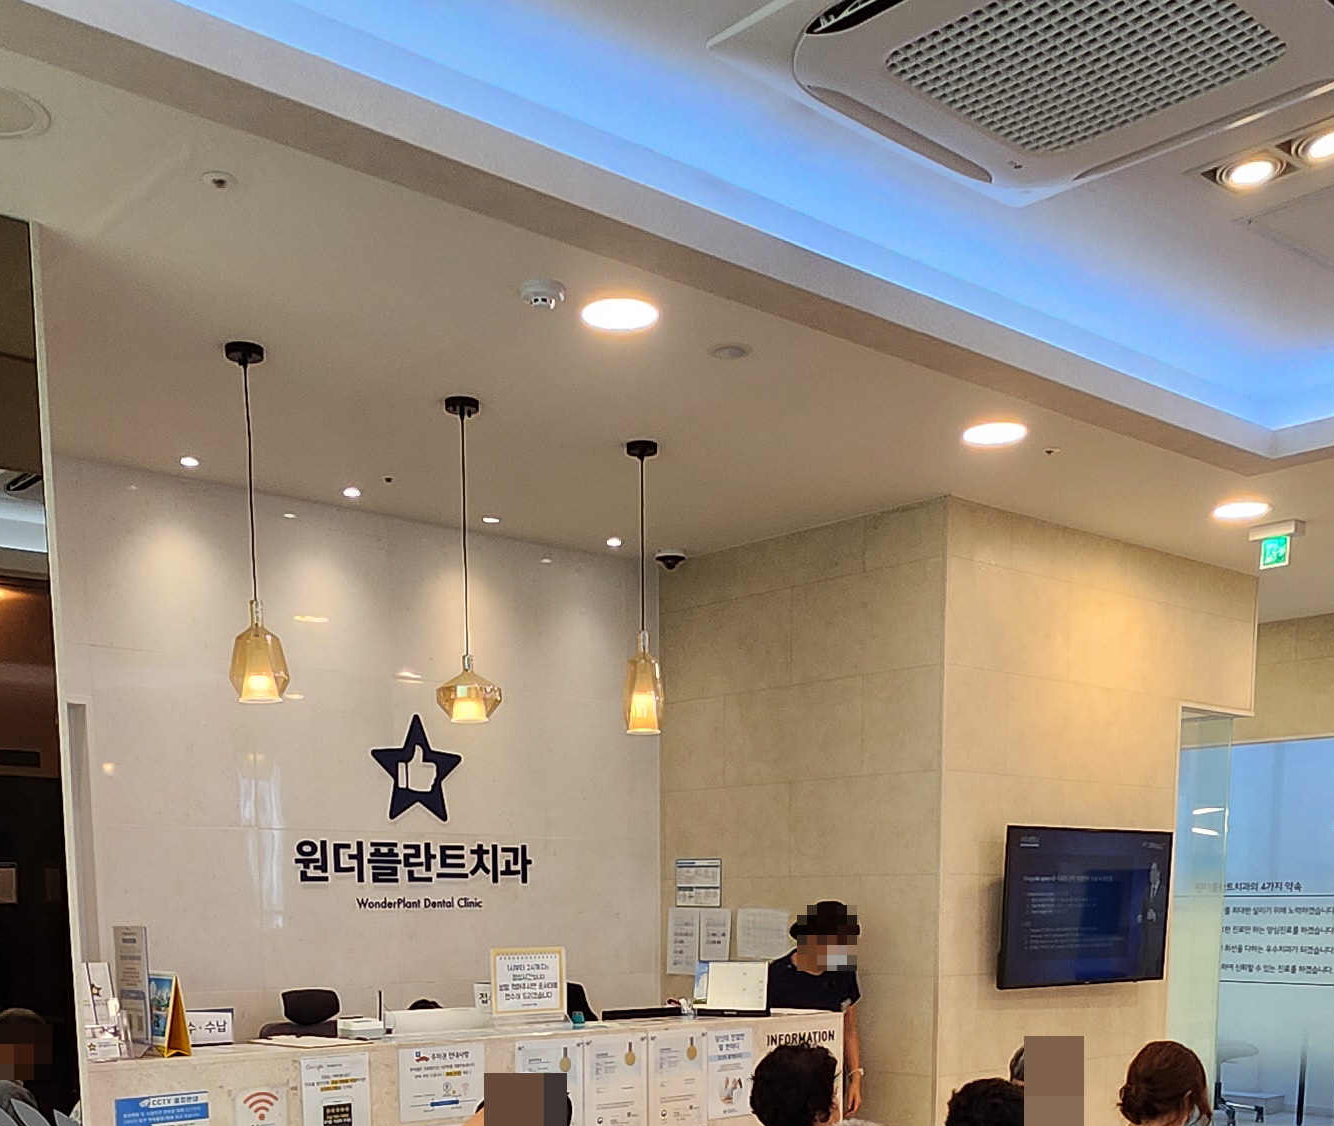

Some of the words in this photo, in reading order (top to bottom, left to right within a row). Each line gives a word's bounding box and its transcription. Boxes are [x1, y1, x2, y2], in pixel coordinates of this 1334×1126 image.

[294, 839, 533, 884] 원더플란트치과
[1261, 881, 1283, 892] 4가지
[1284, 881, 1303, 893] 약속
[356, 897, 421, 910] WonderPlant
[423, 897, 455, 909] Dental
[457, 896, 483, 909] Clinic
[766, 1030, 835, 1047] INFORMATION
[152, 1098, 172, 1106] CCTV
